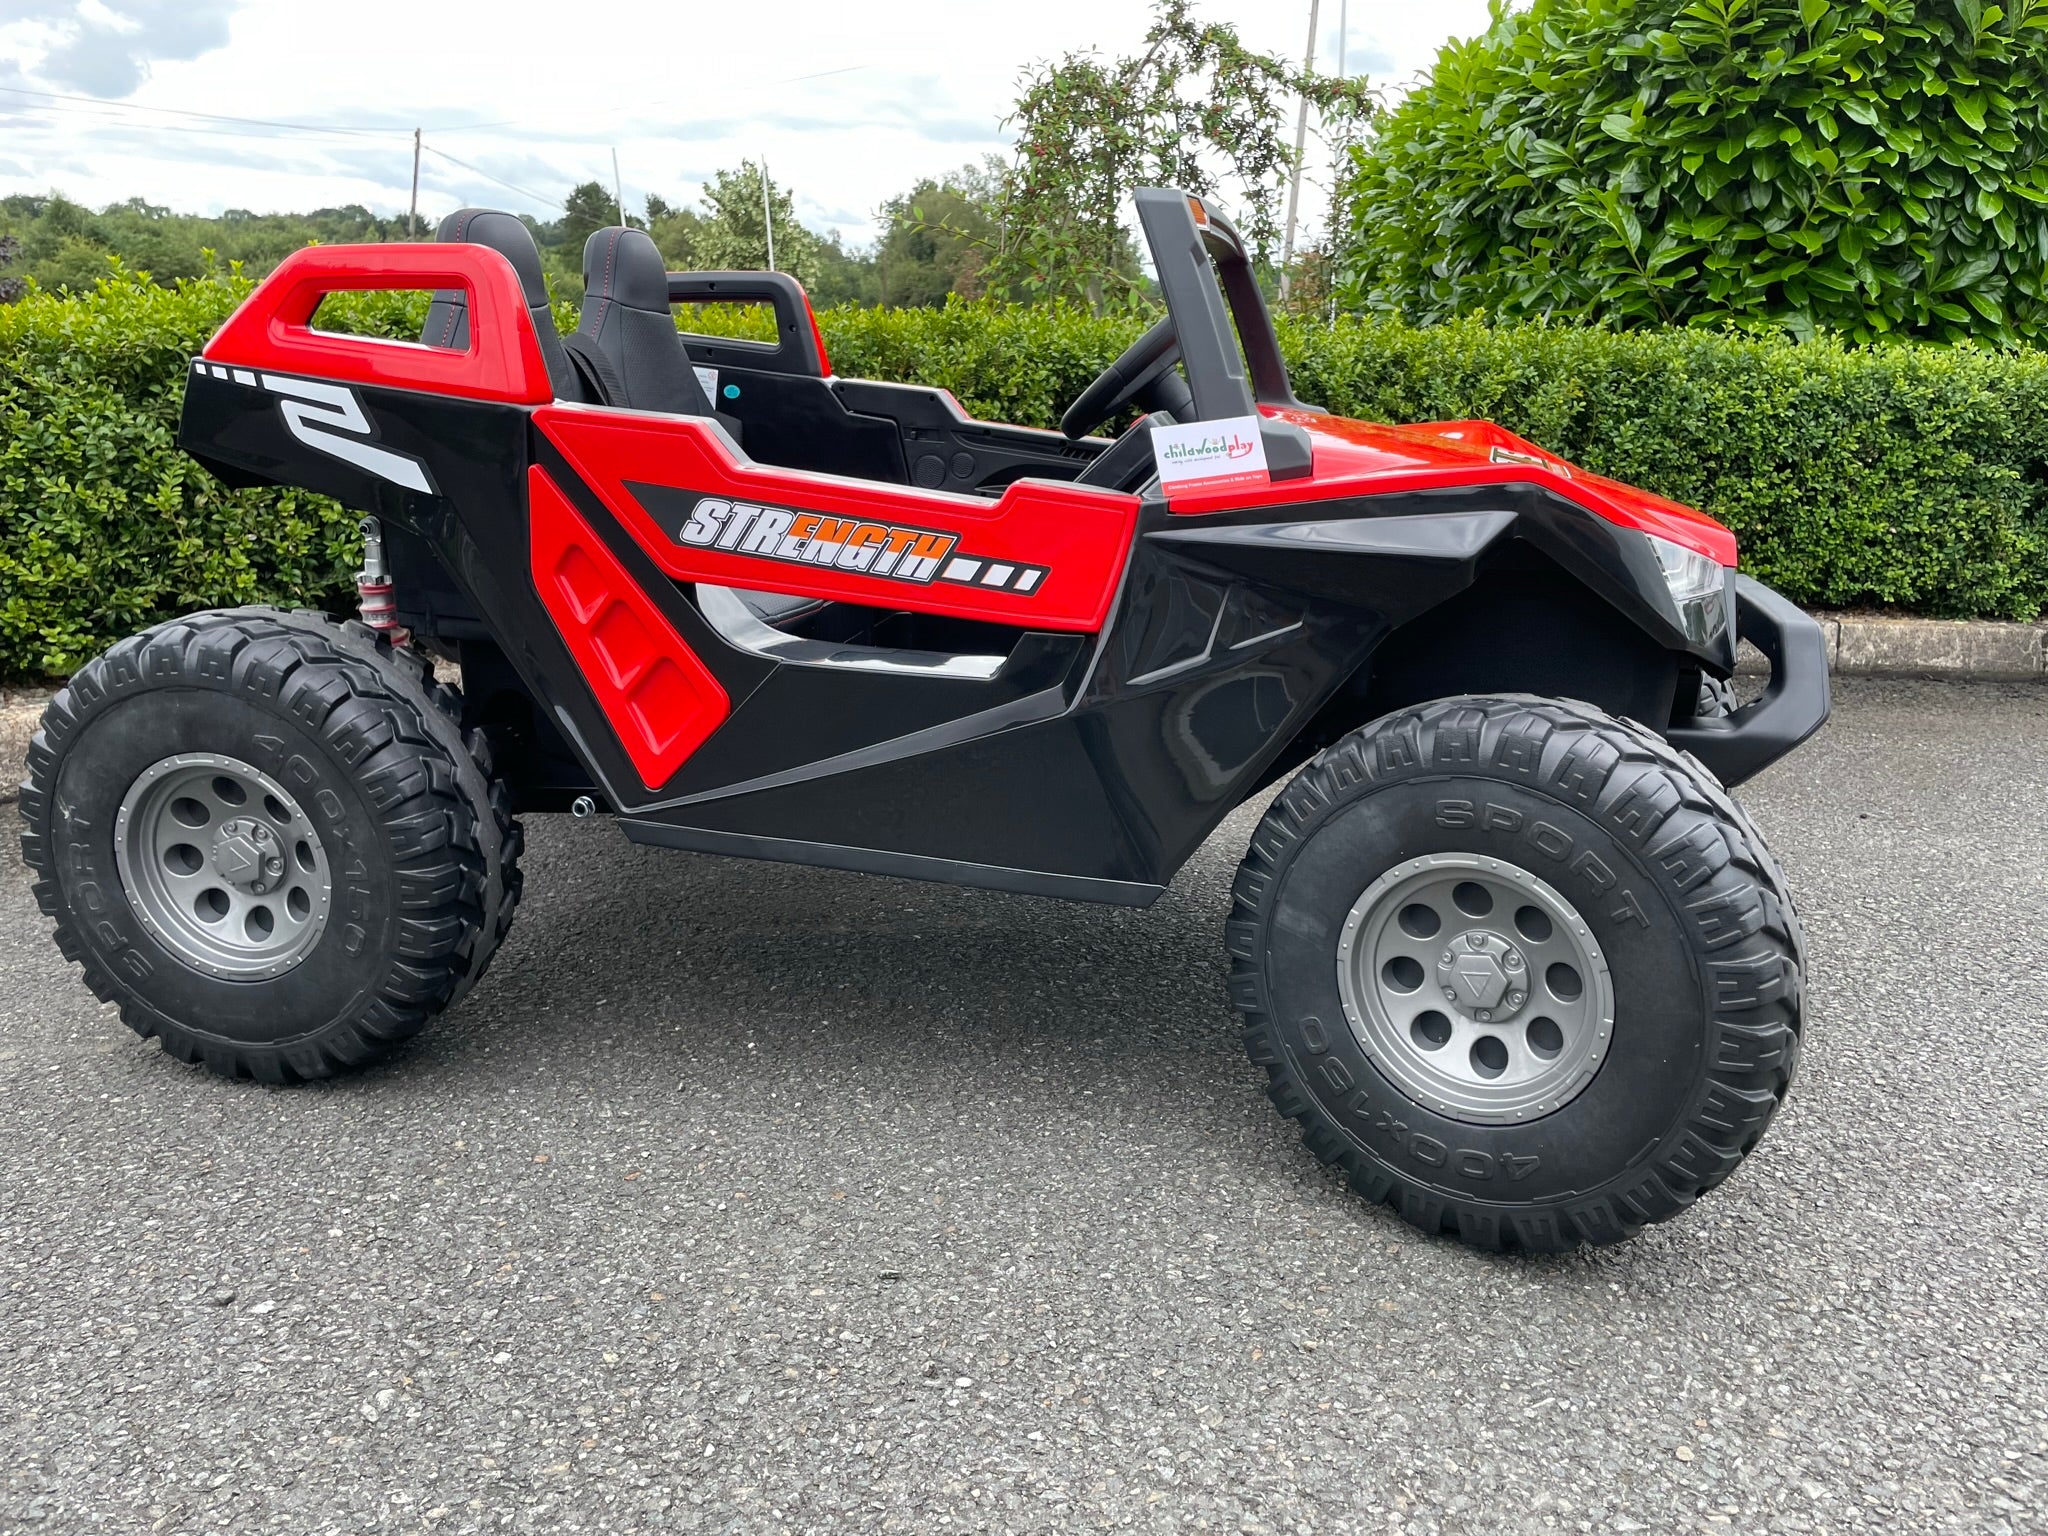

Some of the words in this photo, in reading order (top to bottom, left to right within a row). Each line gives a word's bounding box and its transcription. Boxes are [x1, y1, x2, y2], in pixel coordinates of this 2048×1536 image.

[680, 498, 958, 583] STRENGTH
[67, 800, 154, 977] SPORT
[1435, 800, 1650, 929] SPORT
